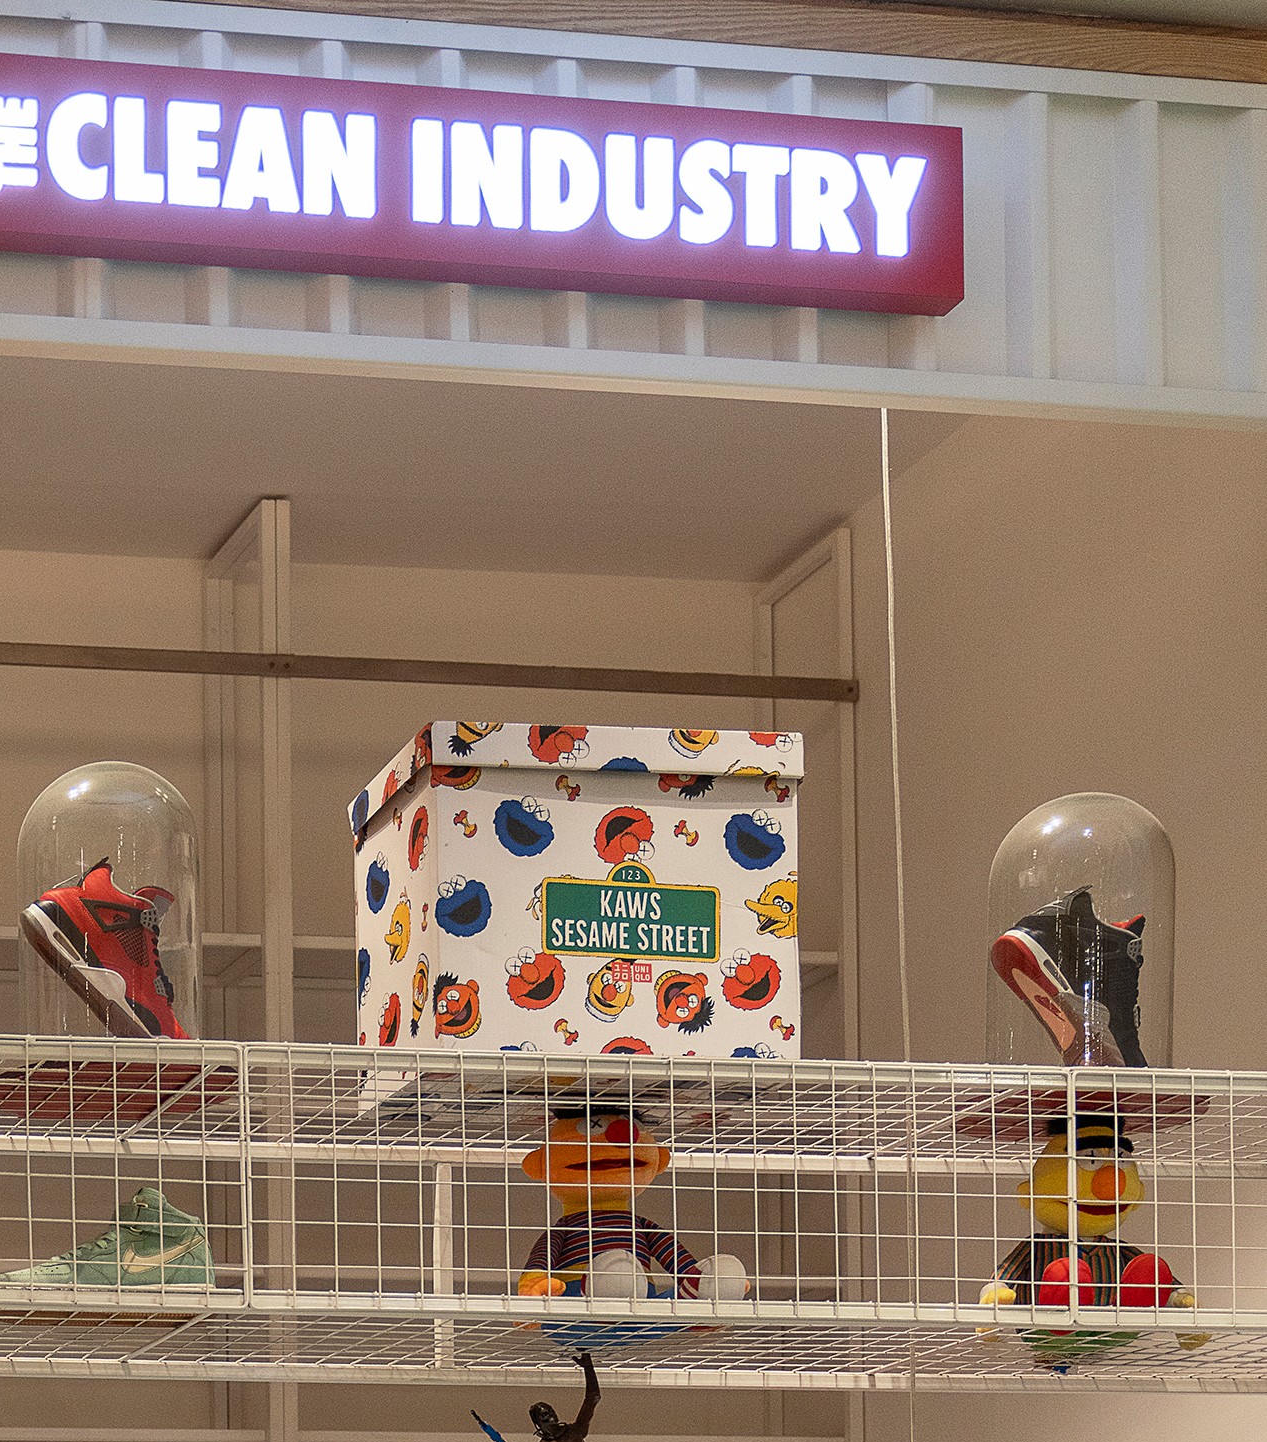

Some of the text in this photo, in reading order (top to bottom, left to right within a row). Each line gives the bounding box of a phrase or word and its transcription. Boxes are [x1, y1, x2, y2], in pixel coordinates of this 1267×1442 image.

[45, 92, 377, 218] CLEAN
[411, 118, 926, 258] INDUSTRY
[621, 870, 641, 880] 123
[600, 890, 661, 920] KAWS
[551, 918, 710, 953] SESAME STREET
[634, 974, 651, 982] QLO
[635, 965, 649, 973] UNI
